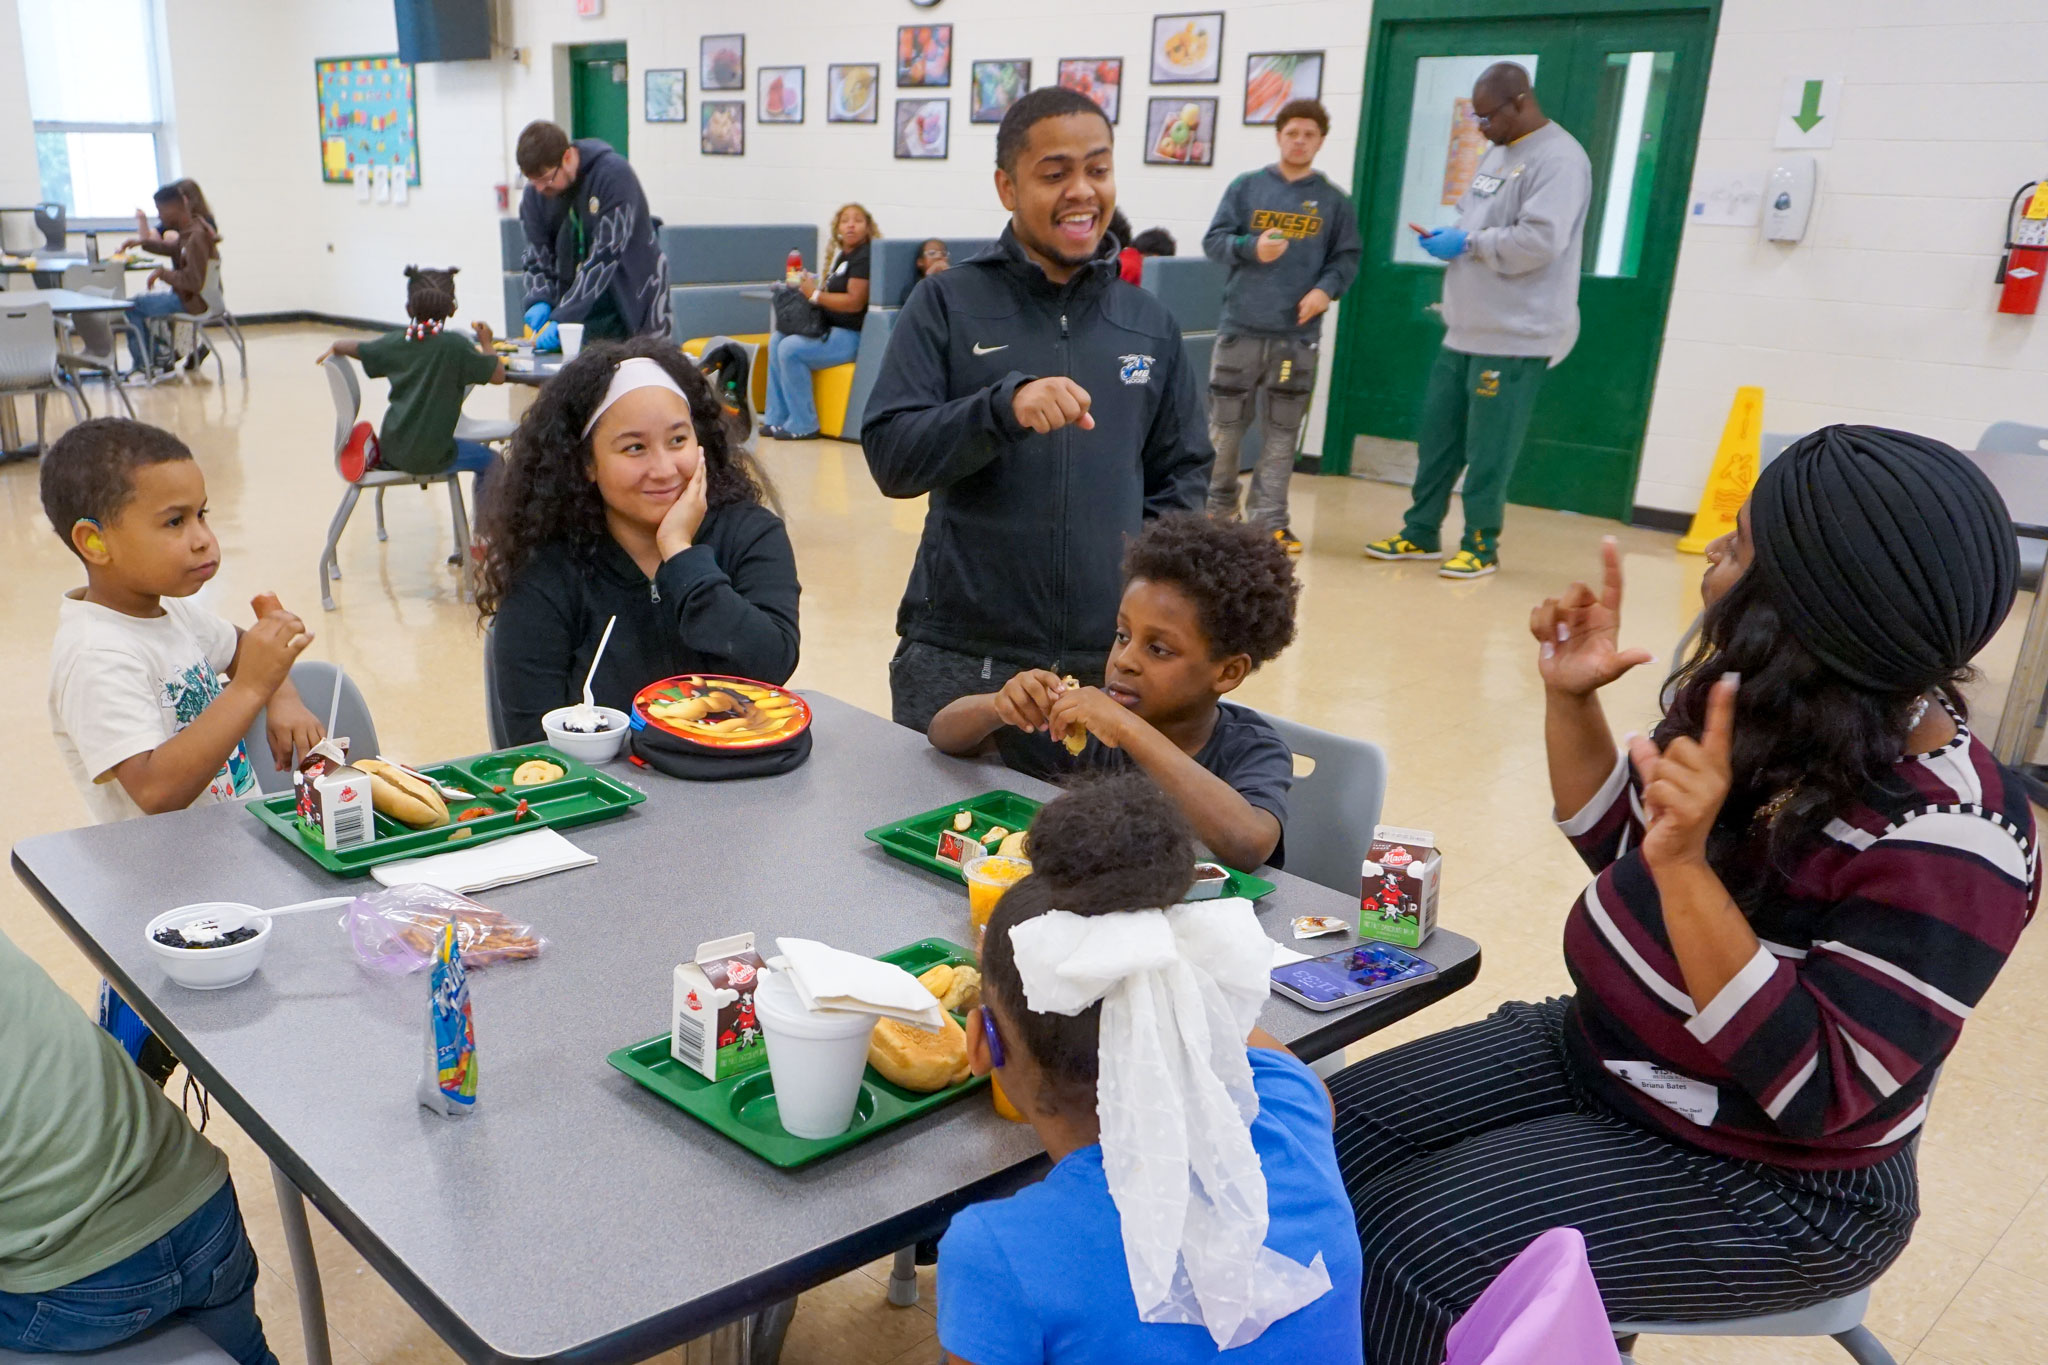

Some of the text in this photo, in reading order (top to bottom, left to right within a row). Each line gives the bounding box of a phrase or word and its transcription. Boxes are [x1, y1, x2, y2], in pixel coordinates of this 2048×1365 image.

[1252, 211, 1322, 234] ENCSD
[1384, 852, 1413, 864] Maola
[729, 964, 757, 982] Maola
[1641, 1081, 1687, 1090] Briana Bates
